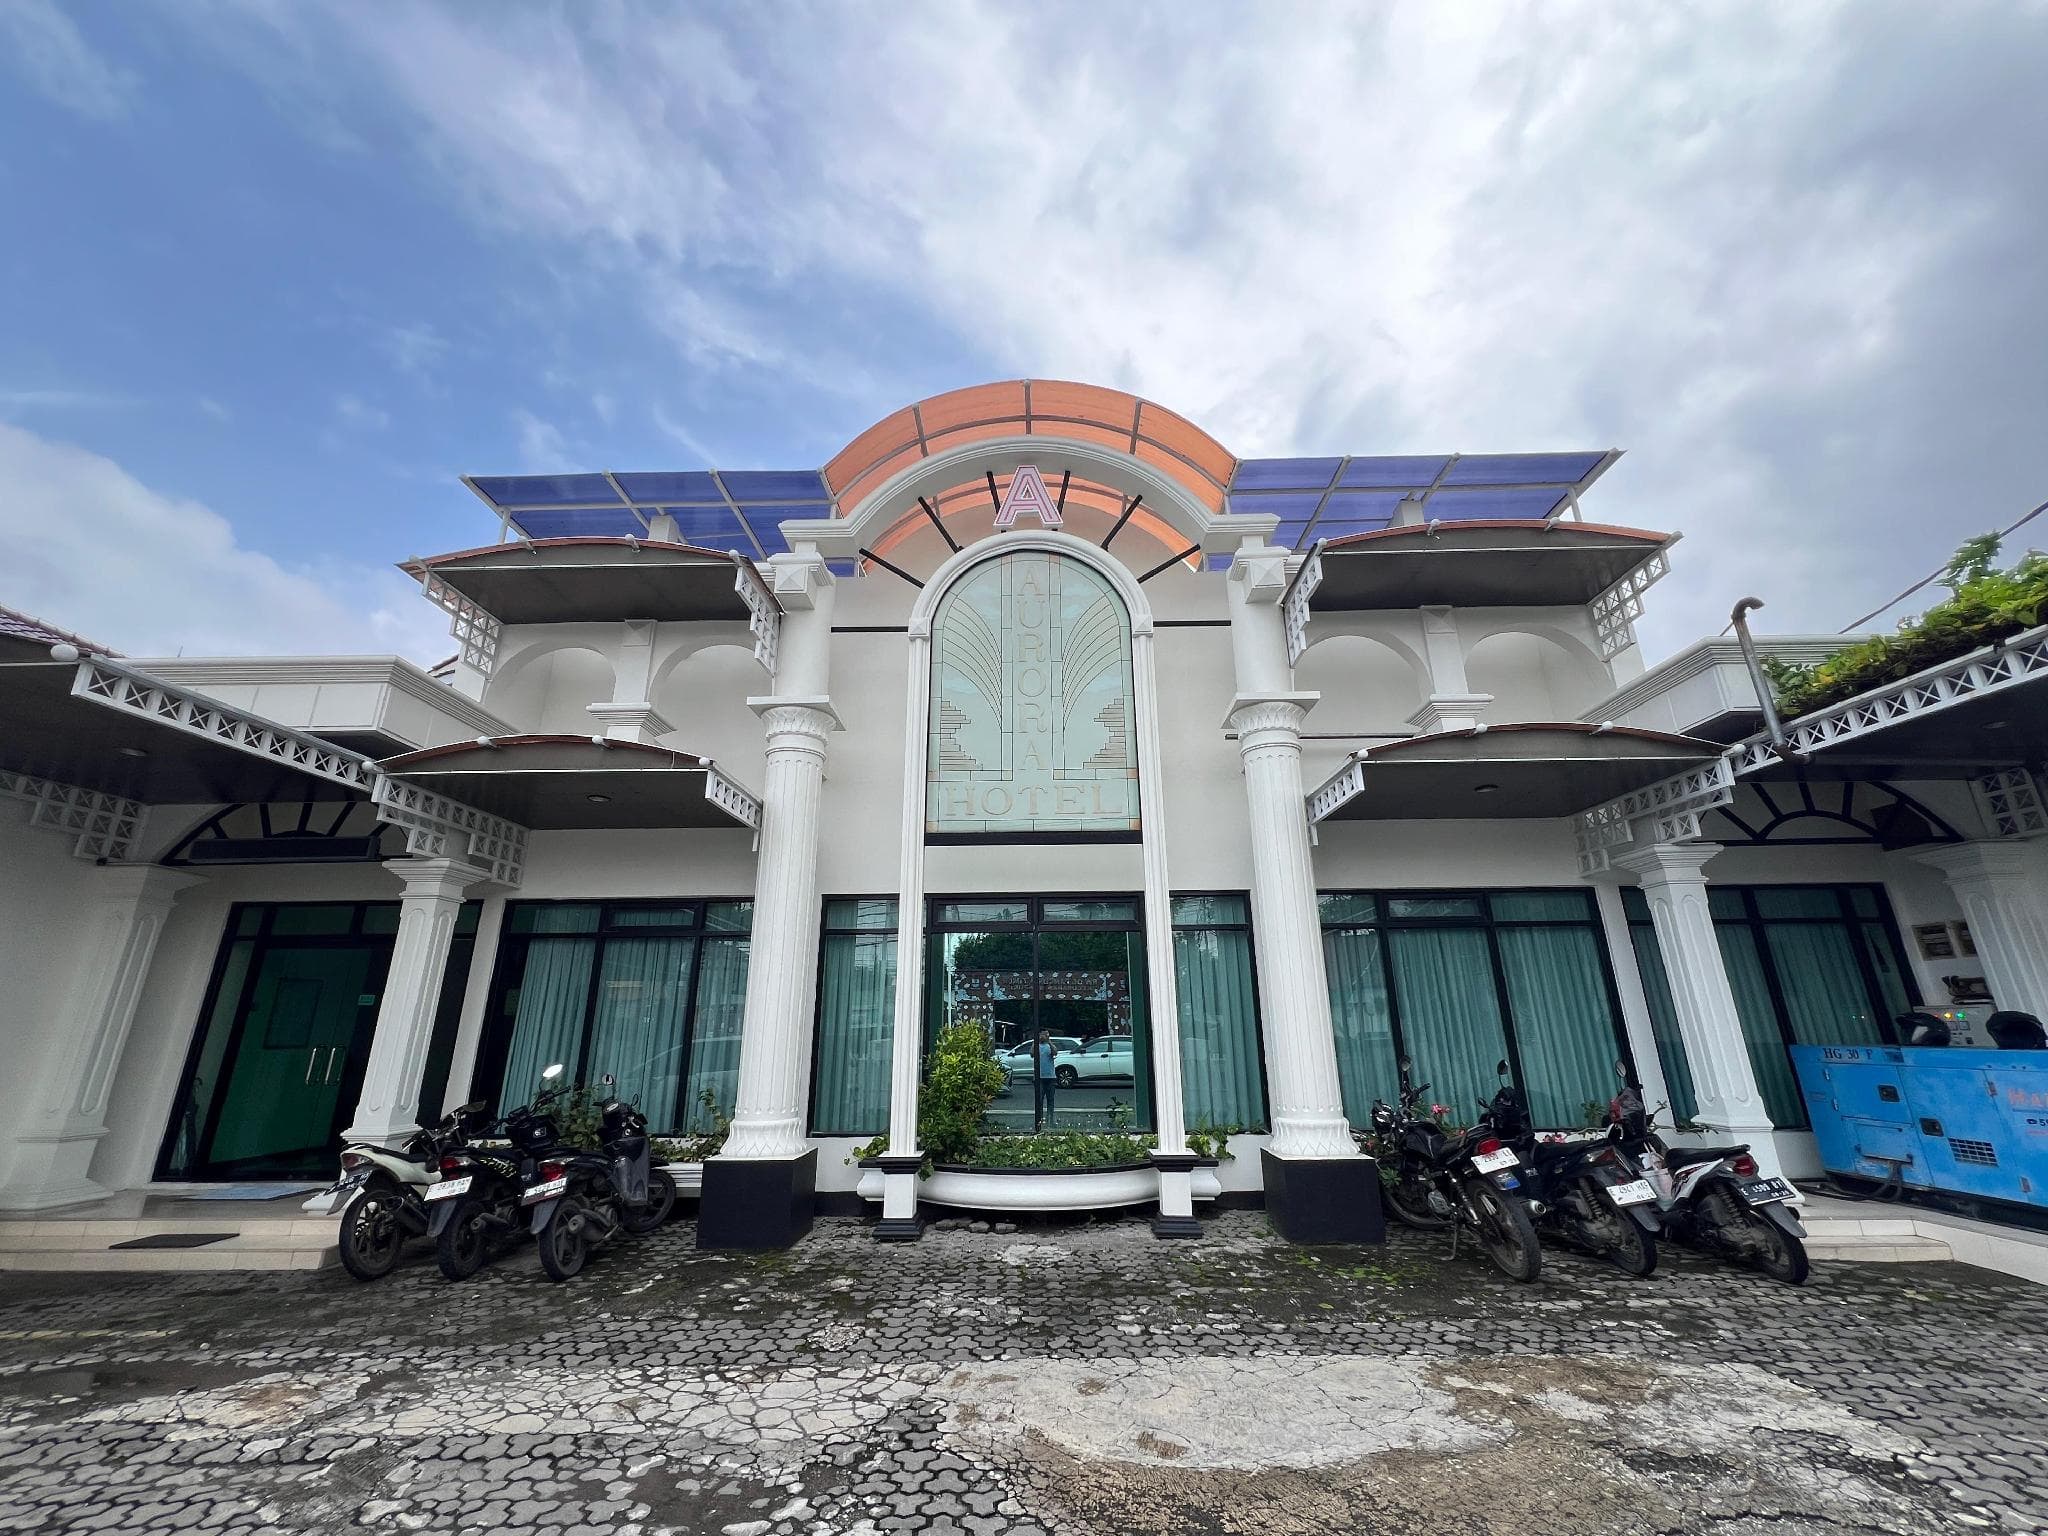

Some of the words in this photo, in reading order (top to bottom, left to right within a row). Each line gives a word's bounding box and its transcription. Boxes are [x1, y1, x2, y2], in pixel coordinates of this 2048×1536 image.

[993, 464, 1064, 529] A
[1015, 563, 1050, 771] AURORA
[945, 783, 1123, 817] HOTEL
